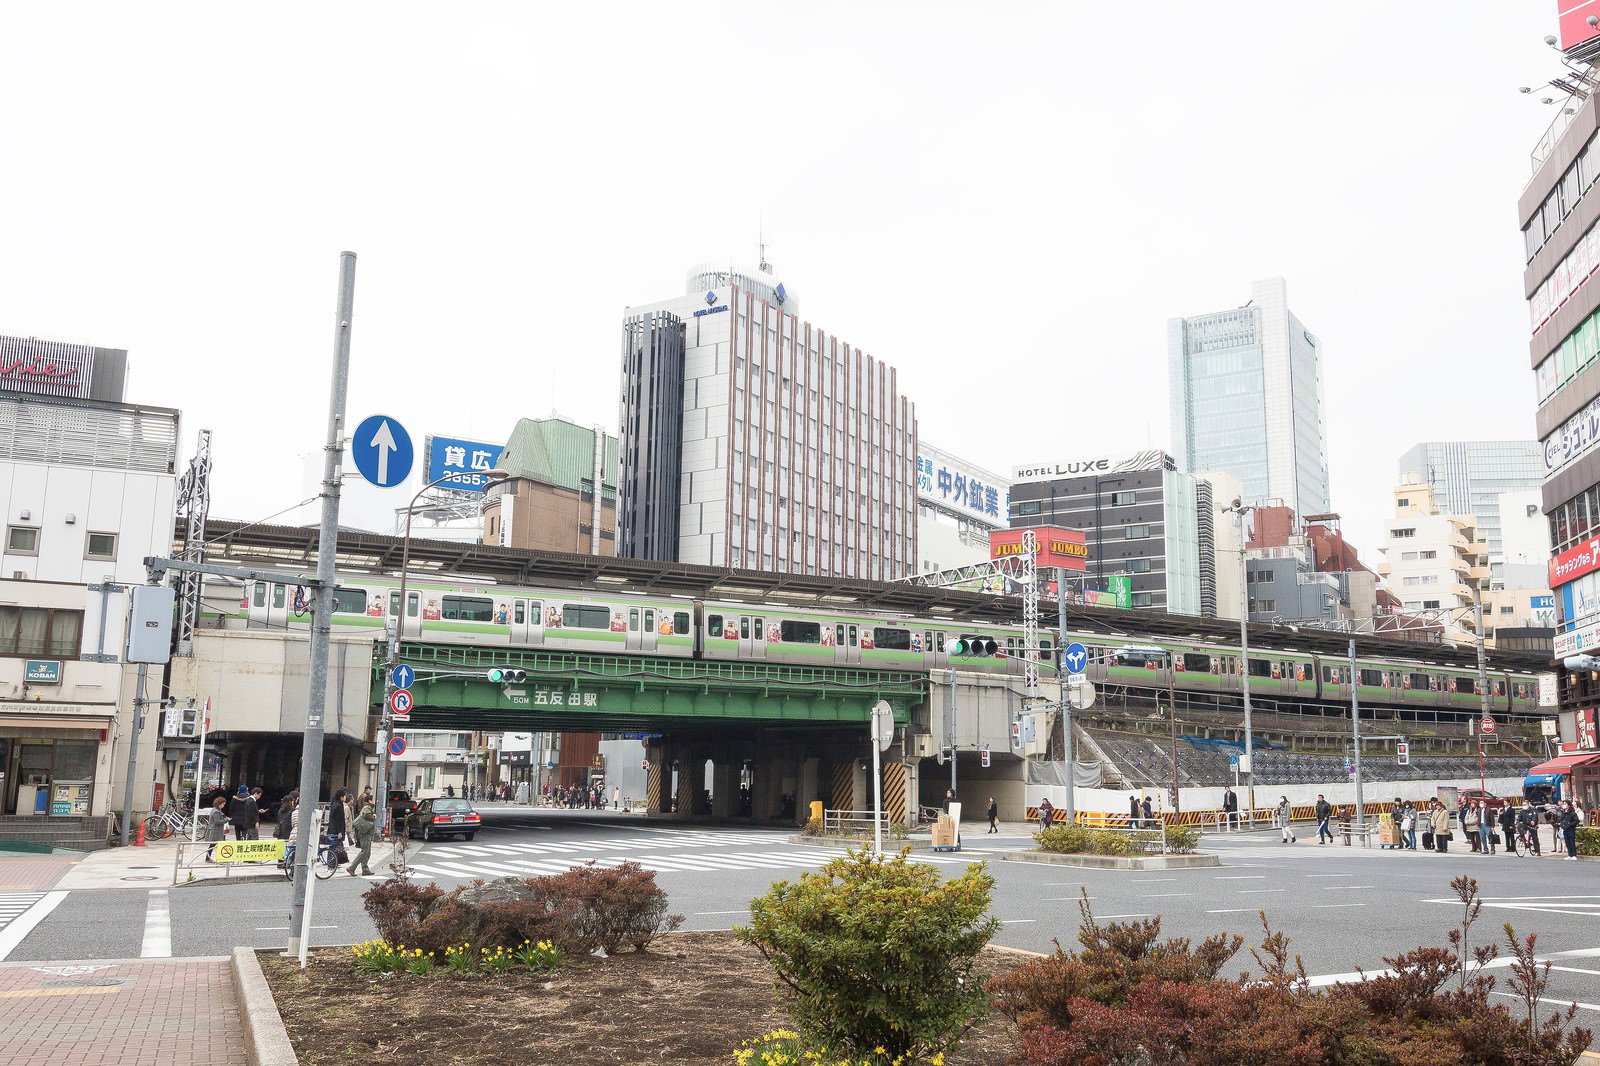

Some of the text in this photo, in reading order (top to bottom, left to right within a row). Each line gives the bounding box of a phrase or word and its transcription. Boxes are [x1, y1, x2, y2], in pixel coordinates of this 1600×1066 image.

[443, 445, 502, 471] 貸広
[1018, 467, 1053, 478] HOTEL
[1055, 459, 1109, 476] LUXE
[442, 470, 491, 486] 3855-
[937, 466, 999, 518] 中外鉱業
[995, 542, 1041, 556] JUMO
[1051, 540, 1089, 557] JUMBO
[1556, 539, 1600, 577] キャッシングなら ア
[513, 696, 530, 705] 50M
[534, 690, 597, 707] 五反田駅
[236, 843, 277, 854] 路上喫煙禁止
